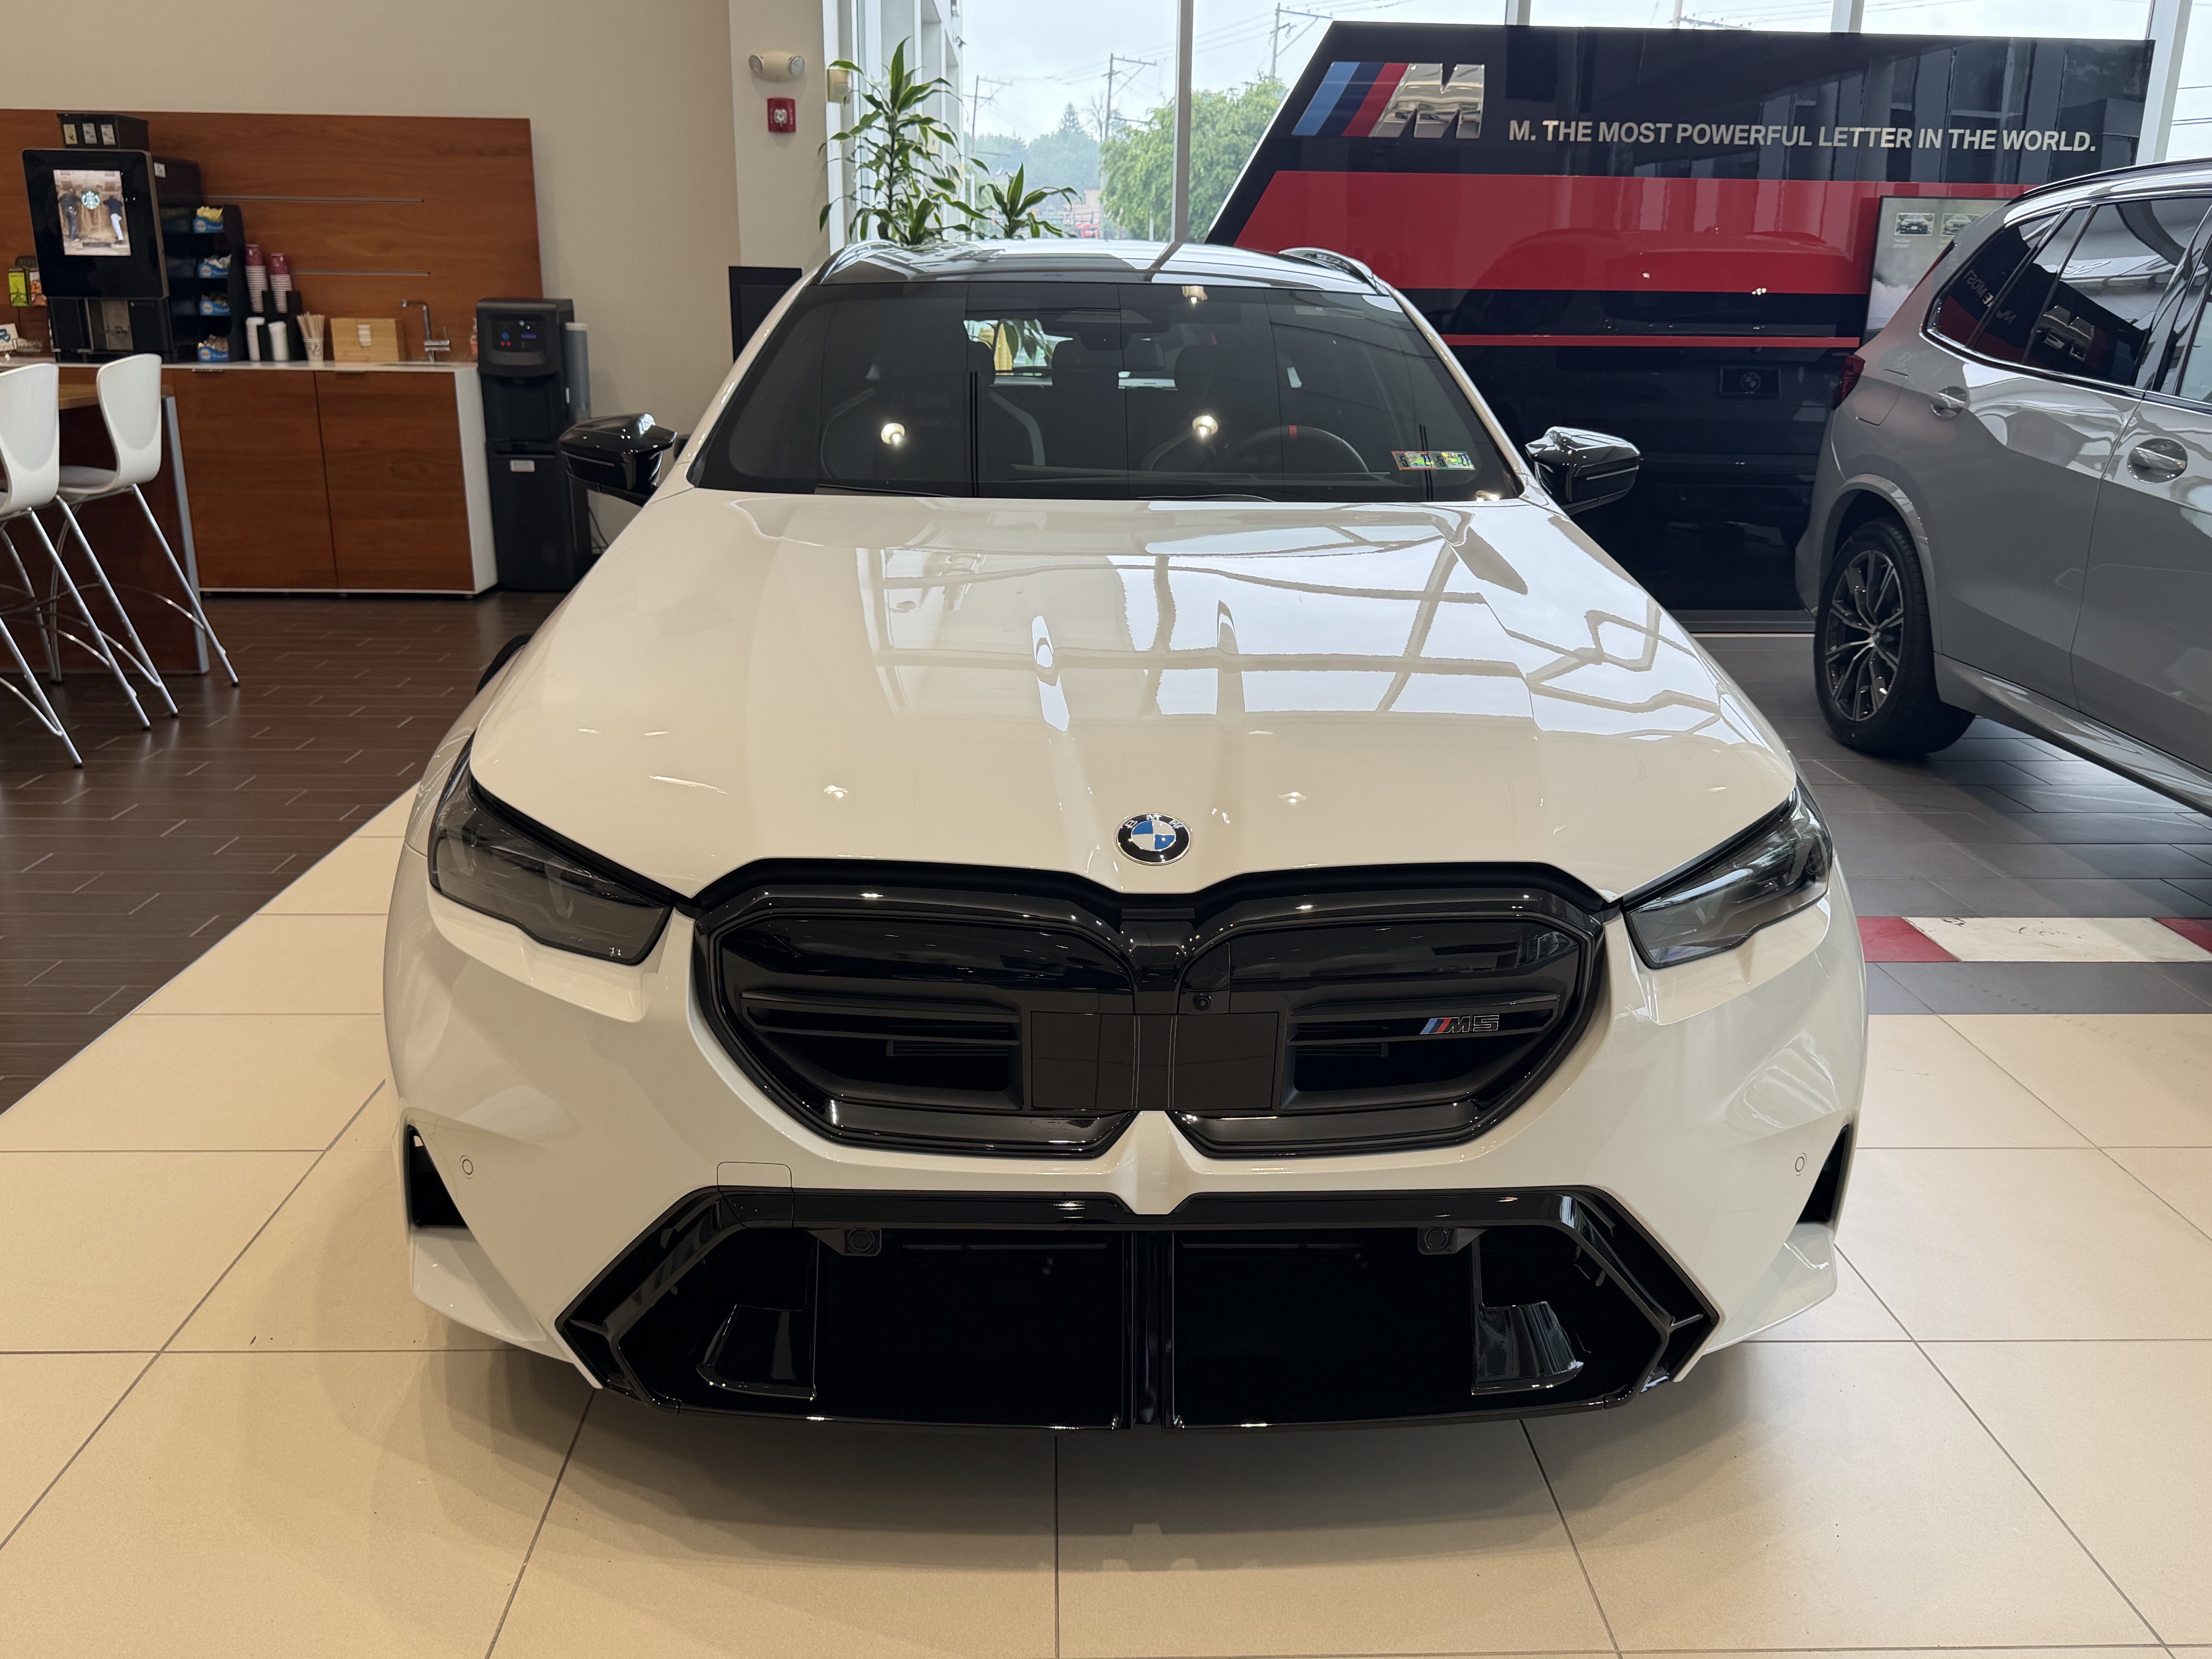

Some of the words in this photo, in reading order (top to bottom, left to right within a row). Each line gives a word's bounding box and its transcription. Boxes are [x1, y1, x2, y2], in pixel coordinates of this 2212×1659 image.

[1509, 120, 1536, 141] M.
[1542, 120, 1593, 142] THE
[1598, 122, 1672, 143] MOST
[1676, 124, 1812, 146] POWERFUL
[1819, 126, 1912, 148] LETTER
[1918, 128, 1942, 149] IN
[1948, 129, 1997, 149] THE
[2002, 130, 2096, 151] WORLD.
[1124, 814, 1183, 829] BMW
[1443, 1015, 1499, 1033] M5
